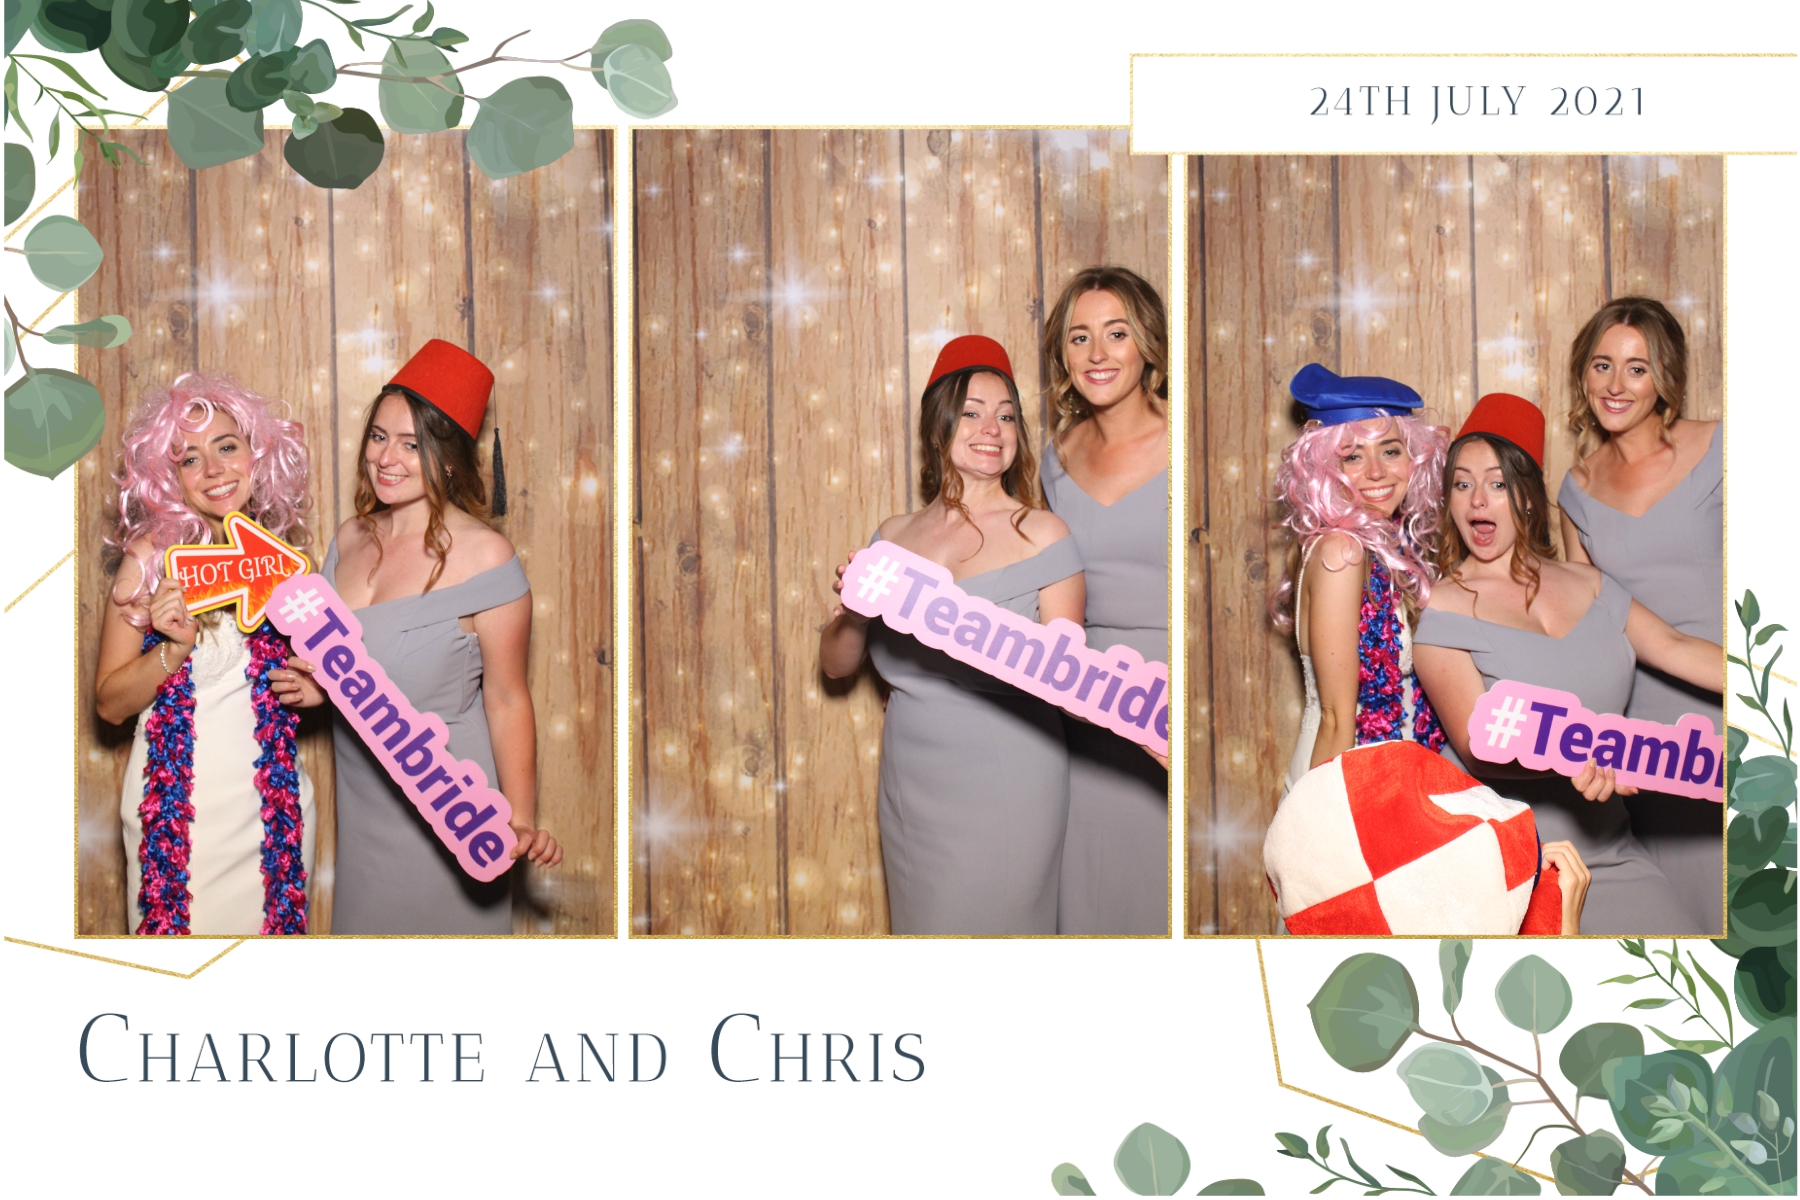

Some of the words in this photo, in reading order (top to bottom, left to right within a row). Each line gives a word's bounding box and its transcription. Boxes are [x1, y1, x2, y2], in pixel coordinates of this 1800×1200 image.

[178, 559, 234, 589] HOT
[238, 553, 292, 583] GIRL
[278, 587, 505, 869] #Teambride
